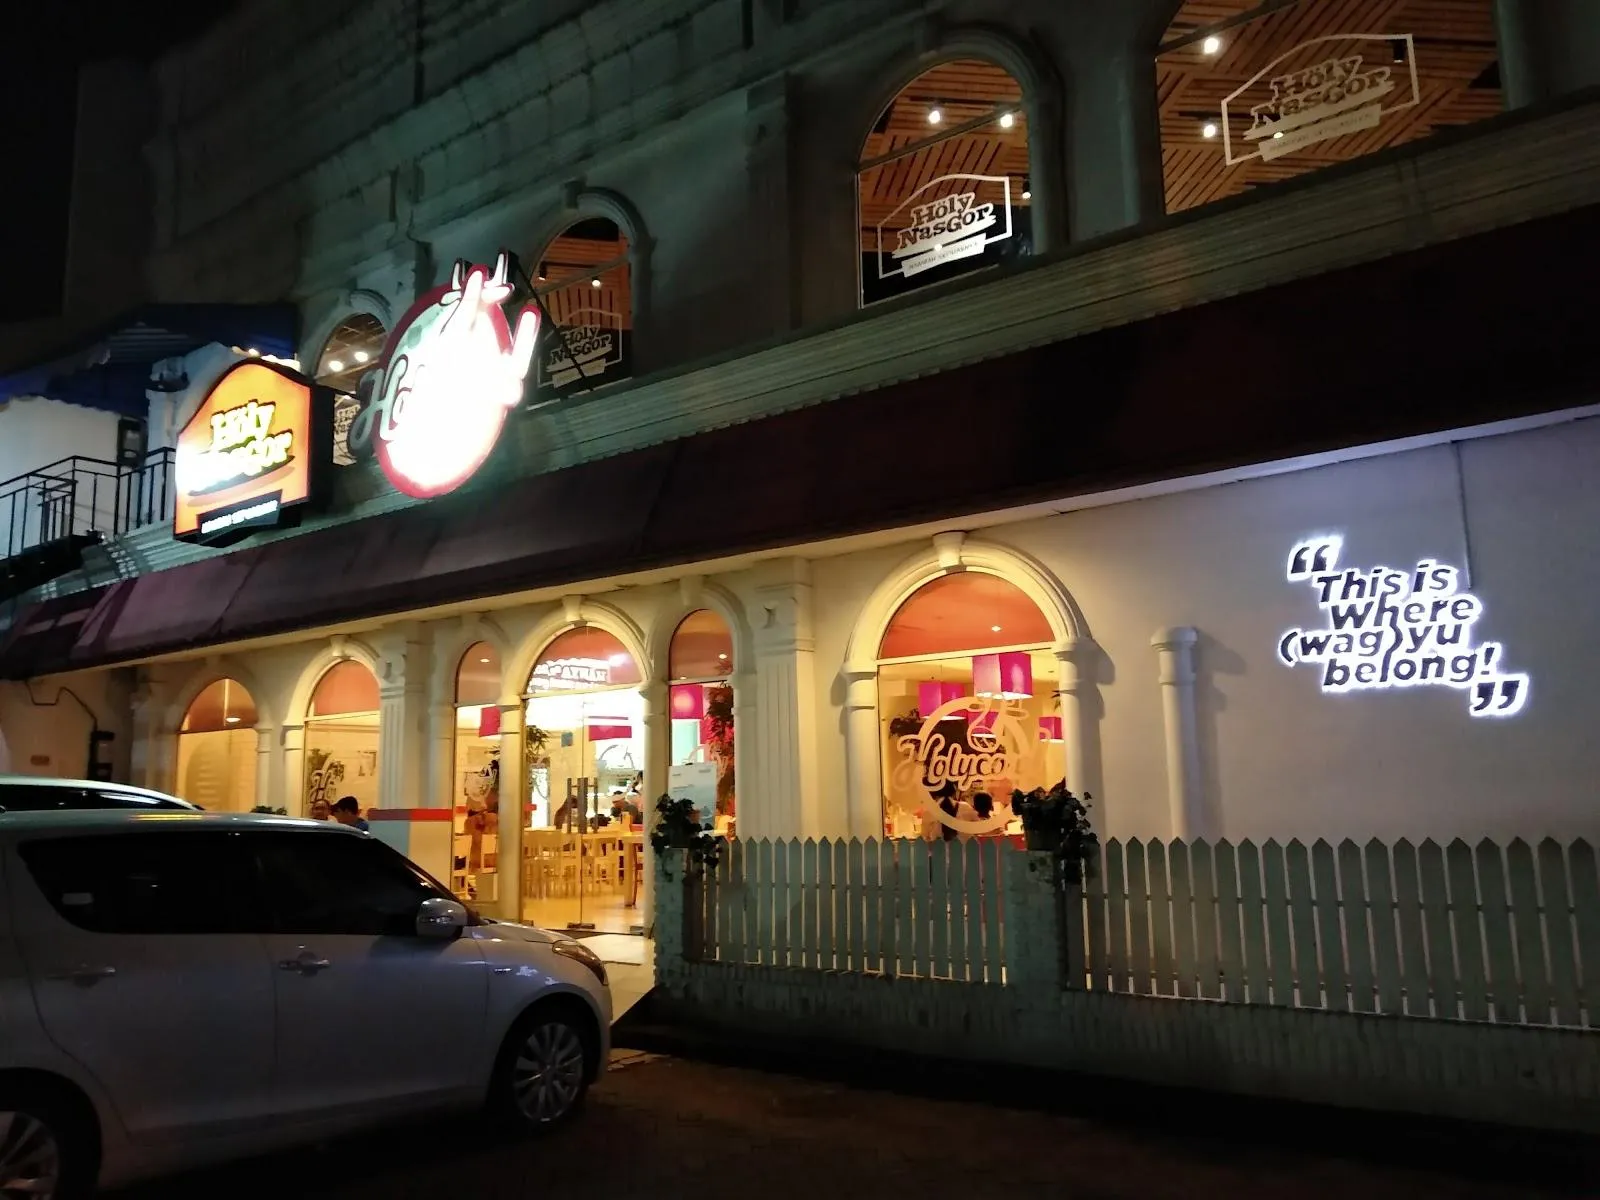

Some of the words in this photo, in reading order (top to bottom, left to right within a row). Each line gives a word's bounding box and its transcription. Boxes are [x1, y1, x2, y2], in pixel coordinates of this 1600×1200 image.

[898, 205, 990, 249] NasGor
[1412, 563, 1452, 593] is
[1330, 591, 1475, 630] where
[893, 732, 1025, 791] Holyco
